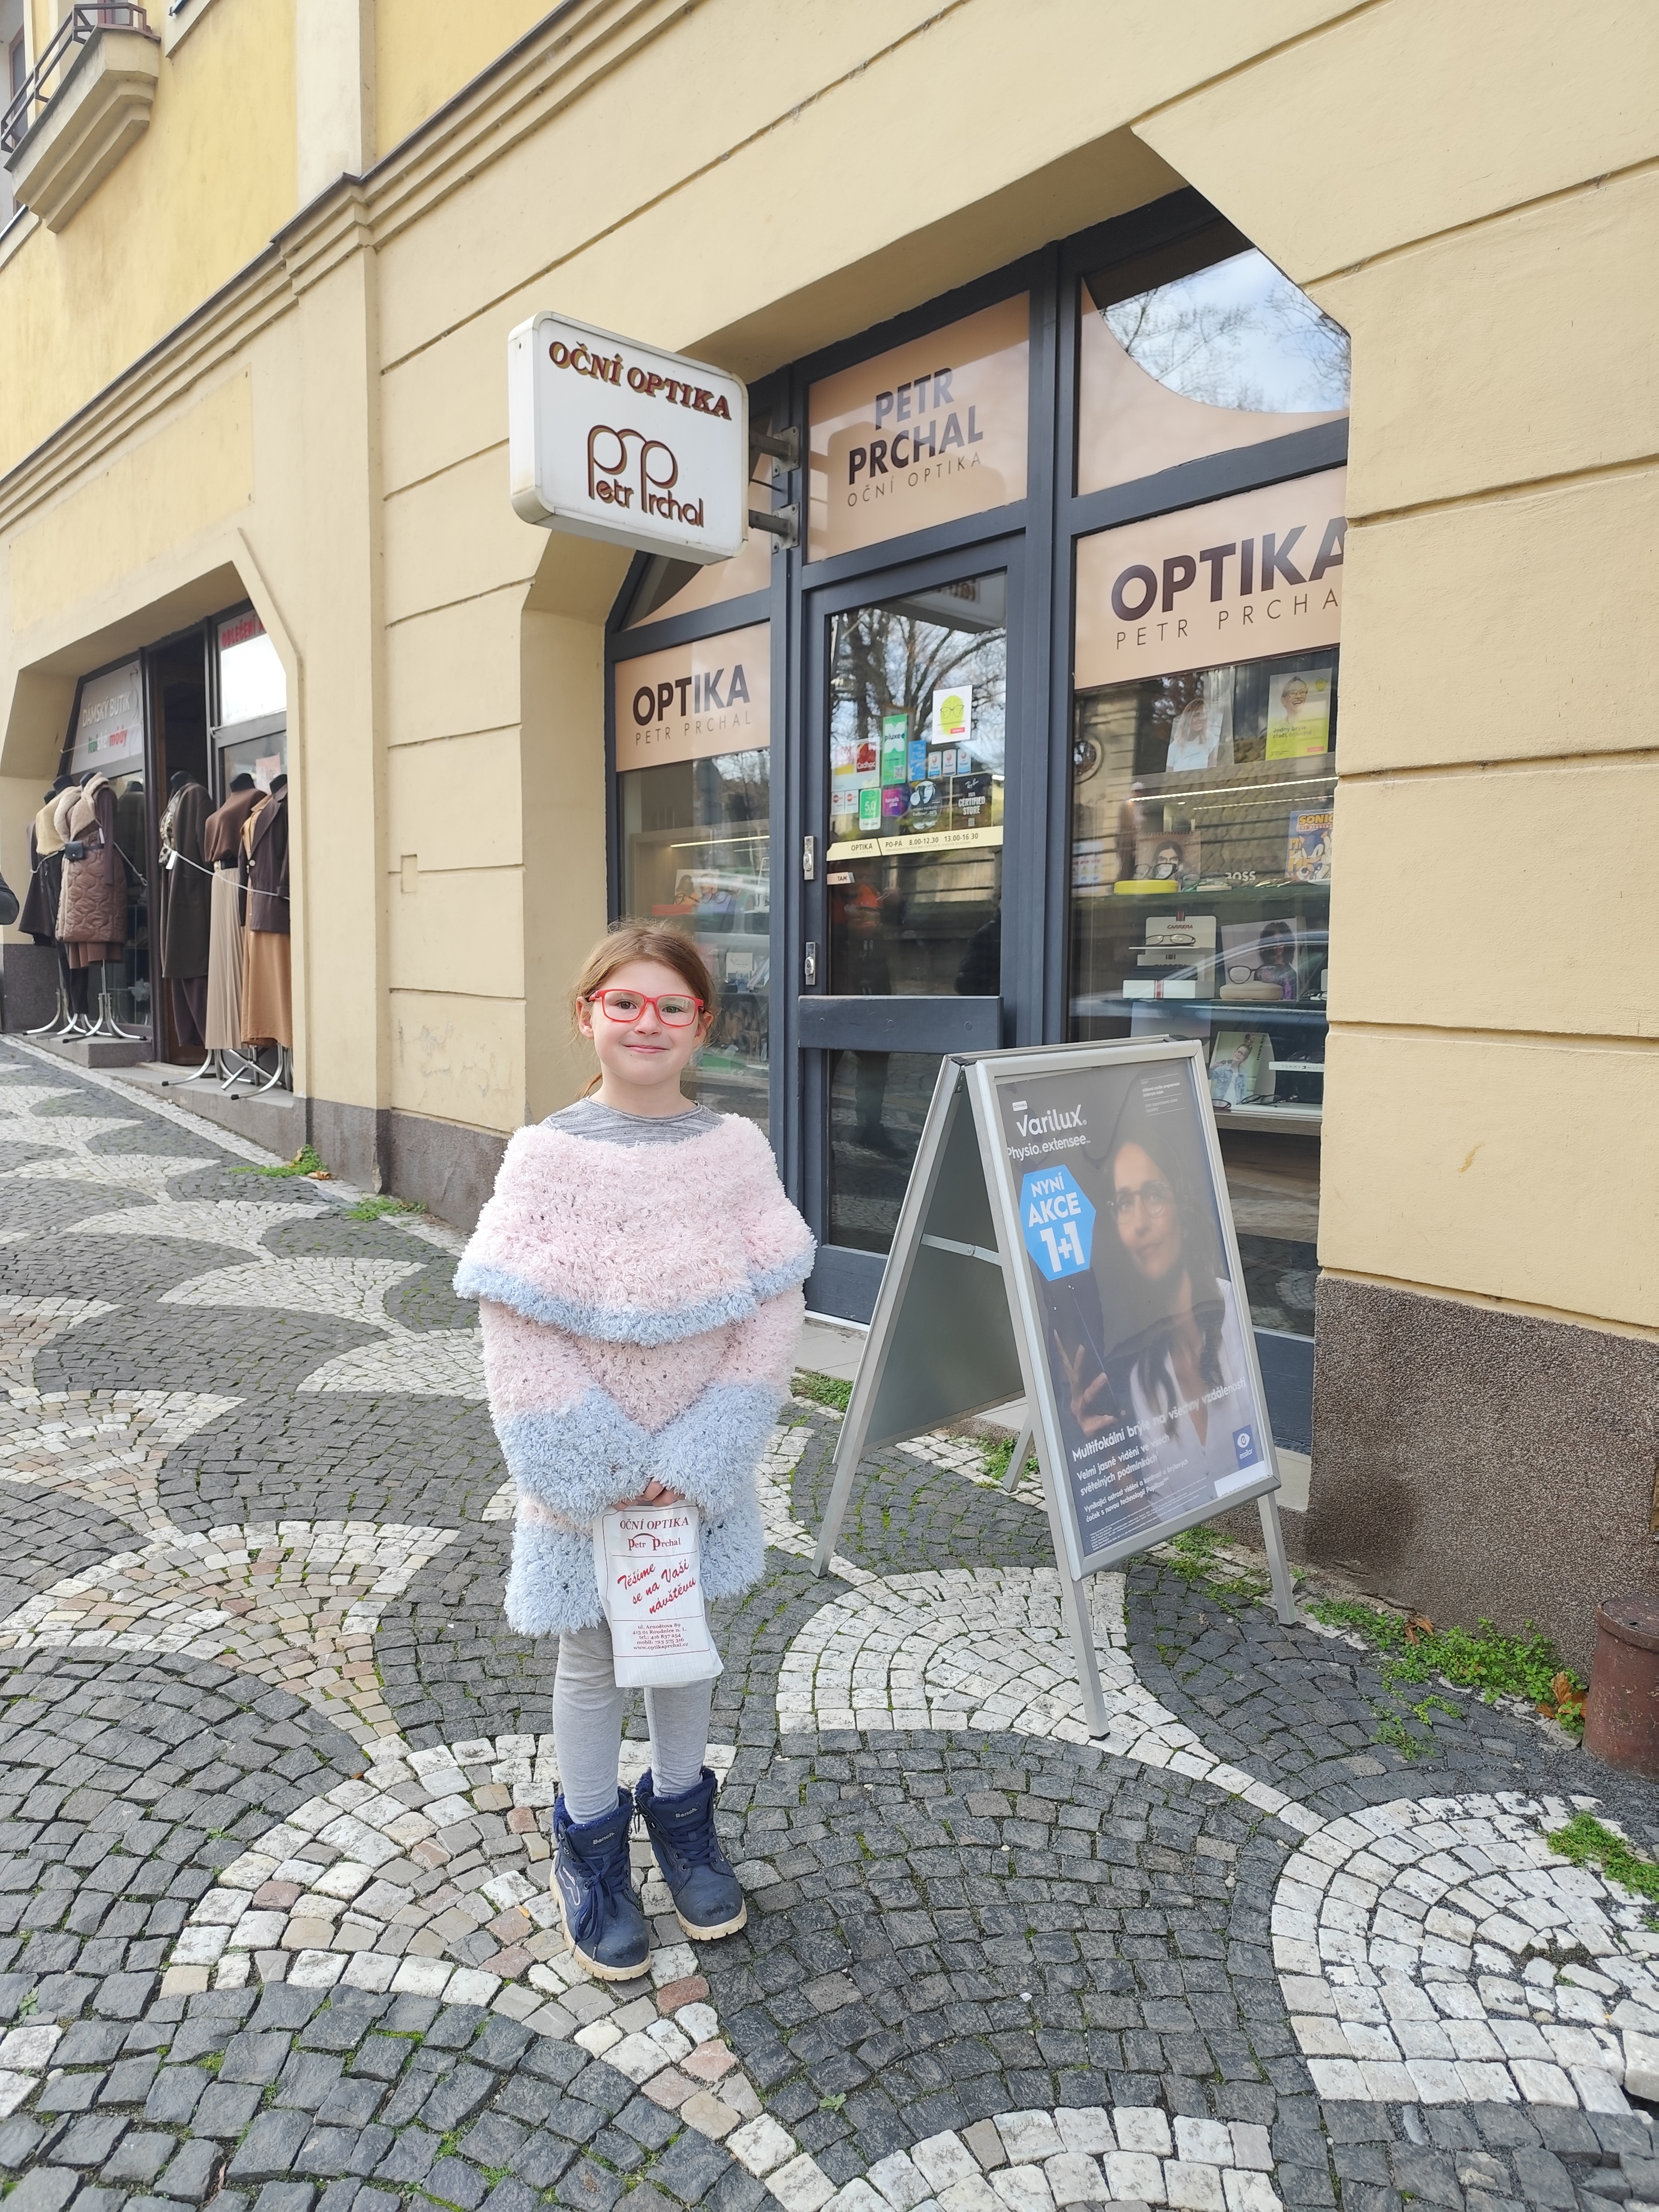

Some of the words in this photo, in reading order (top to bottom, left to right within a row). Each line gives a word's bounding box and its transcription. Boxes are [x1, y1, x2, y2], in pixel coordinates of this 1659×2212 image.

[549, 341, 623, 387] OČNÍ
[627, 367, 732, 420] OPTIKA
[876, 368, 955, 430] PETR
[848, 406, 983, 485] PRCHAL
[587, 425, 634, 509] Petr
[640, 440, 704, 528] Prchal
[847, 475, 895, 507] OČNÍ
[908, 452, 981, 487] OPTIKA
[1111, 516, 1348, 621] OPTIKA
[1116, 619, 1188, 650] PETR
[83, 696, 109, 728] DÁMSKÝ
[110, 691, 131, 718] BUTIK
[633, 664, 750, 726] OPTIKA
[635, 726, 671, 746] PETR
[684, 711, 751, 736] PRCHAL
[885, 732, 905, 741] pluxee
[958, 796, 986, 807] CERTIFIED
[963, 805, 980, 815] STORE
[851, 843, 873, 851] OPTIKA
[885, 839, 902, 847] PO-PÁ
[1031, 1172, 1065, 1198] NYNÍ
[1028, 1192, 1082, 1227] AKCE
[1039, 1221, 1085, 1272] 1+1
[1072, 1427, 1126, 1462] Multifokální
[1126, 1419, 1150, 1438] brýle
[1153, 1414, 1166, 1426] na
[1168, 1398, 1199, 1419] všechny
[1201, 1377, 1246, 1404] vzdálenosti
[1076, 1465, 1097, 1481] Velmi
[1097, 1456, 1116, 1475] jasné
[1118, 1445, 1140, 1462] vidění
[1140, 1443, 1150, 1452] ve
[1150, 1433, 1170, 1448] všech
[1239, 1448, 1253, 1459] essilor
[1080, 1472, 1116, 1496] světelných
[1084, 1496, 1107, 1513] Vynikající
[1108, 1488, 1123, 1502] ostrost
[1124, 1482, 1139, 1494] vidění
[620, 1518, 644, 1530] OČNÍ
[647, 1516, 689, 1530] OPTIKA
[1086, 1512, 1101, 1522] čoček
[1105, 1502, 1120, 1514] novou
[628, 1538, 646, 1551] Petr
[652, 1537, 681, 1551] Prchal
[617, 1563, 655, 1590] Těšíme
[632, 1592, 643, 1604] se
[646, 1582, 660, 1596] na
[661, 1559, 689, 1583] Vaši
[650, 1577, 696, 1615] návštěvu
